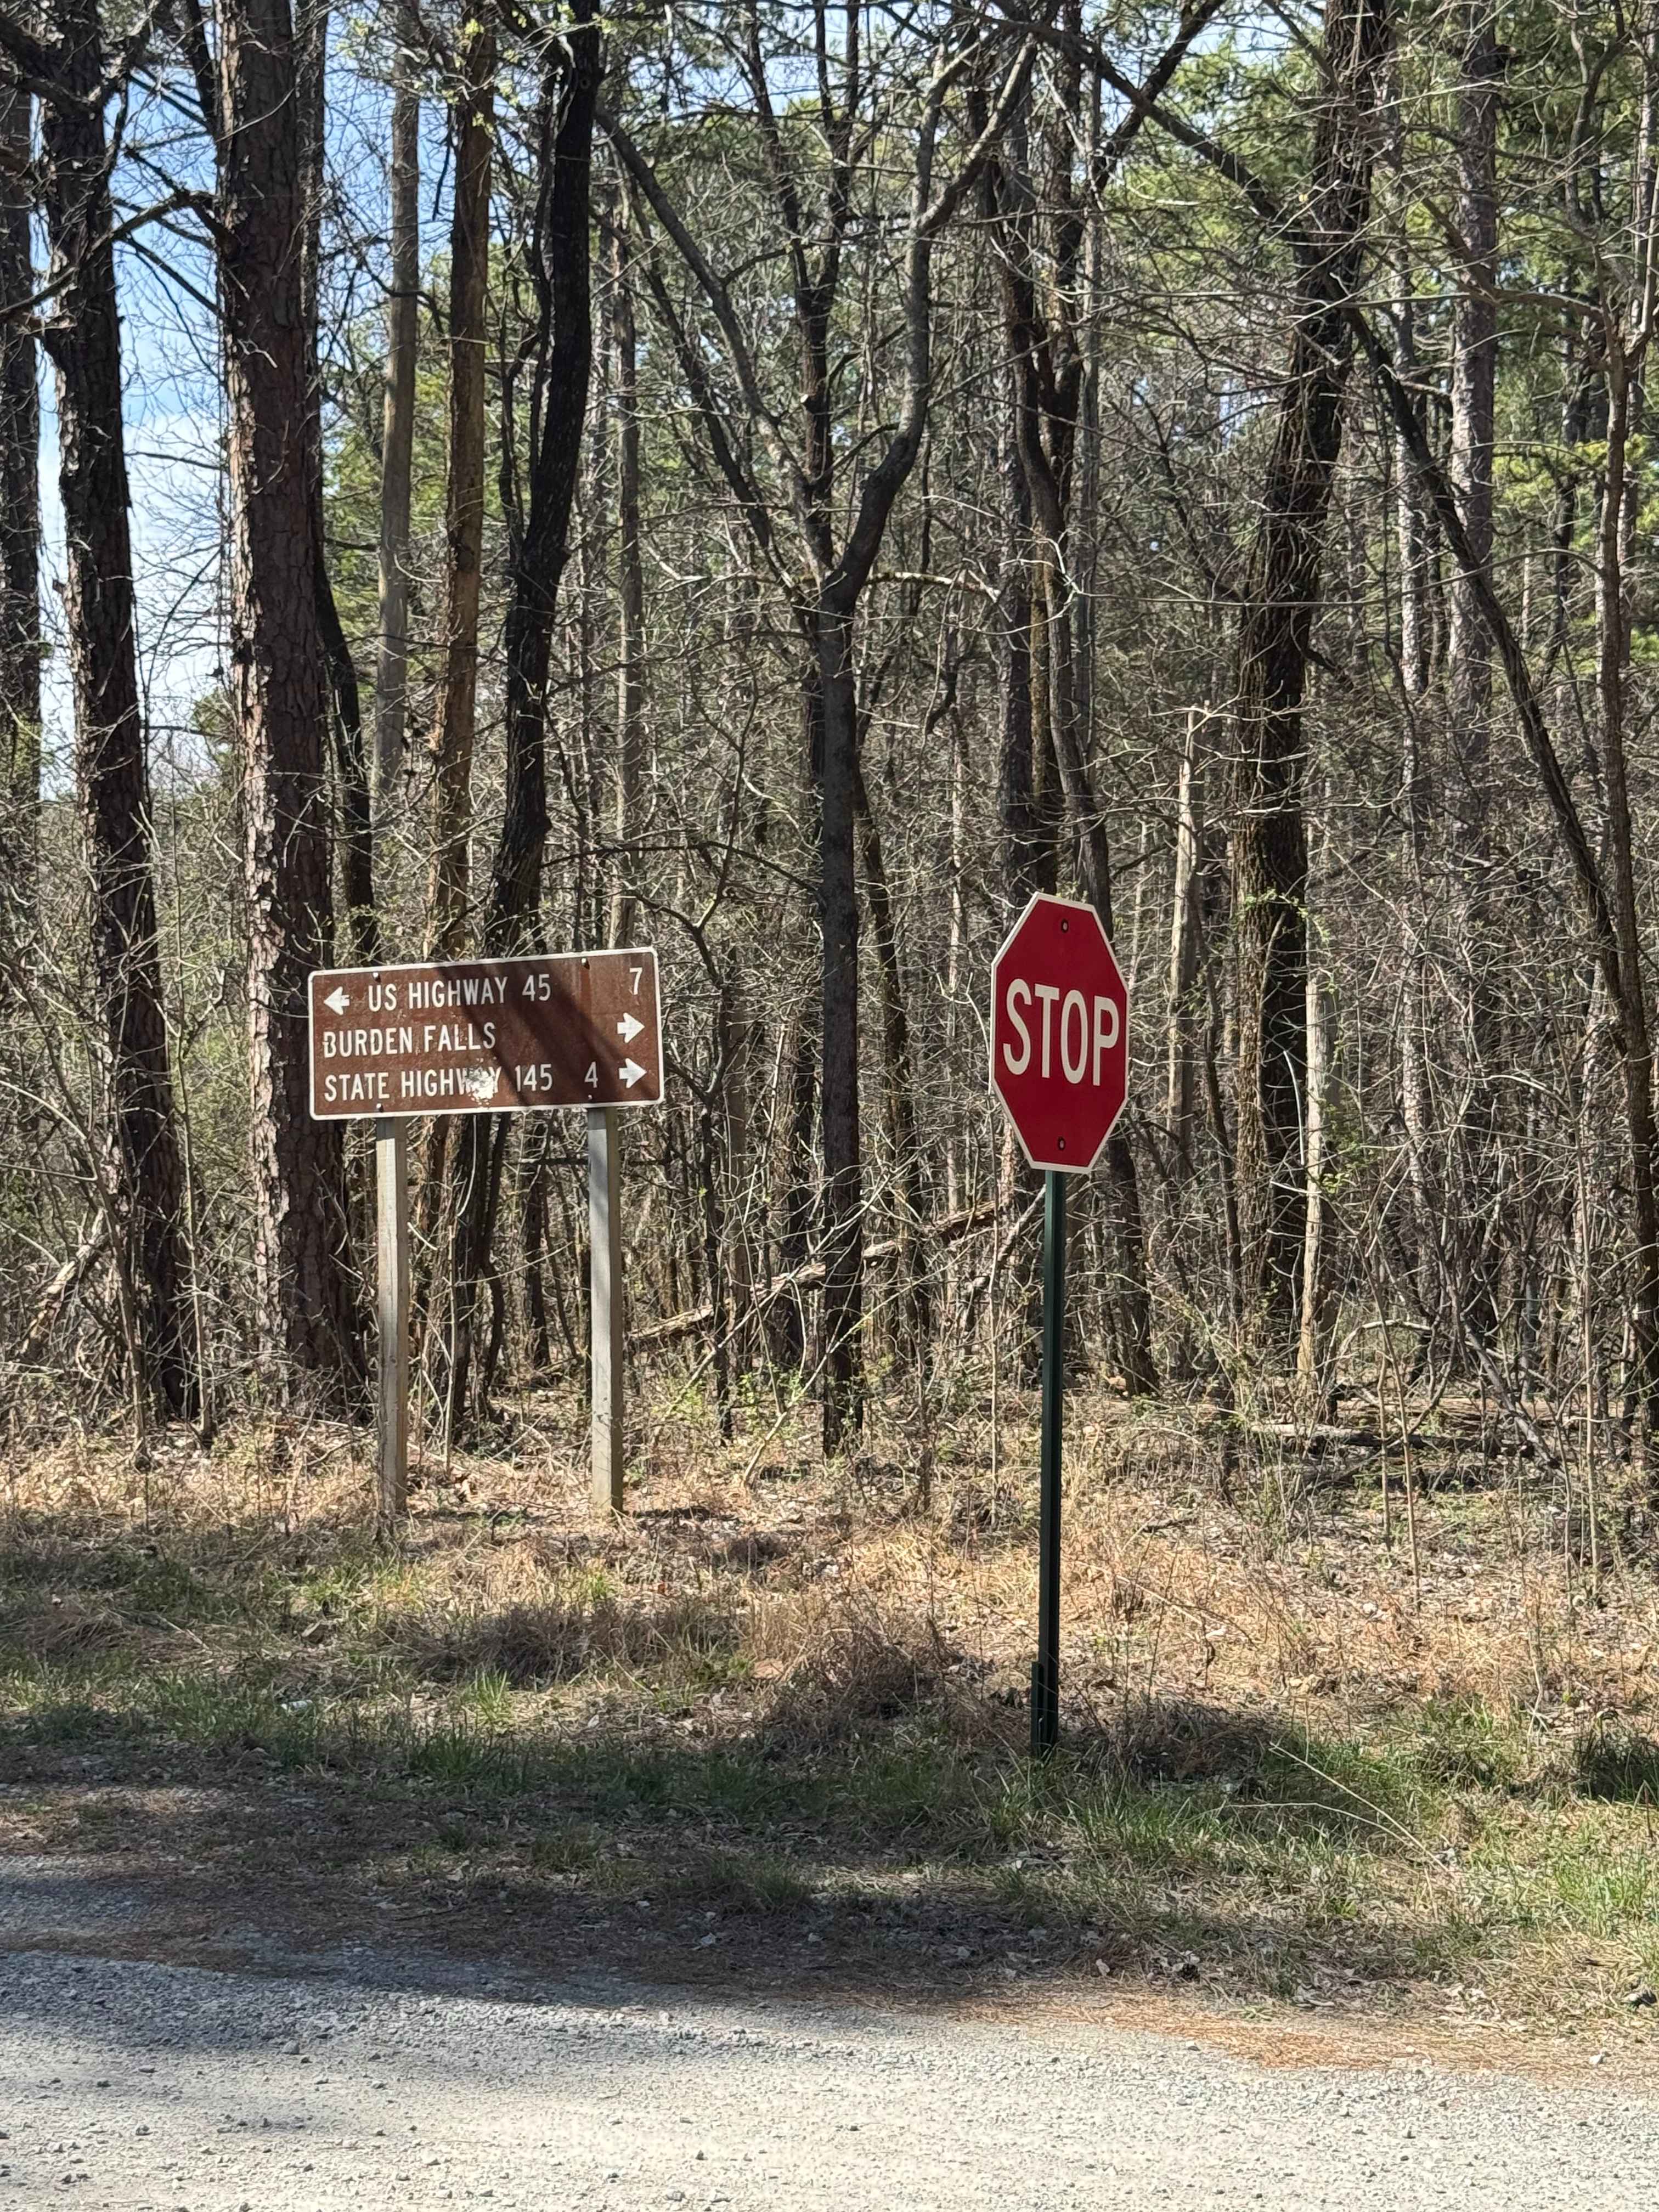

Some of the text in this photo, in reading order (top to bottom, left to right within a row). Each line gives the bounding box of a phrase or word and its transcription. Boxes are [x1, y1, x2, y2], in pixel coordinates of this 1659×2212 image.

[368, 967, 644, 1012] US HIGHWAY 45 7
[323, 1022, 496, 1058] BURDEN FALLS
[1003, 978, 1119, 1086] STOP
[324, 1062, 599, 1102] STATE HIGHWY 145 4
